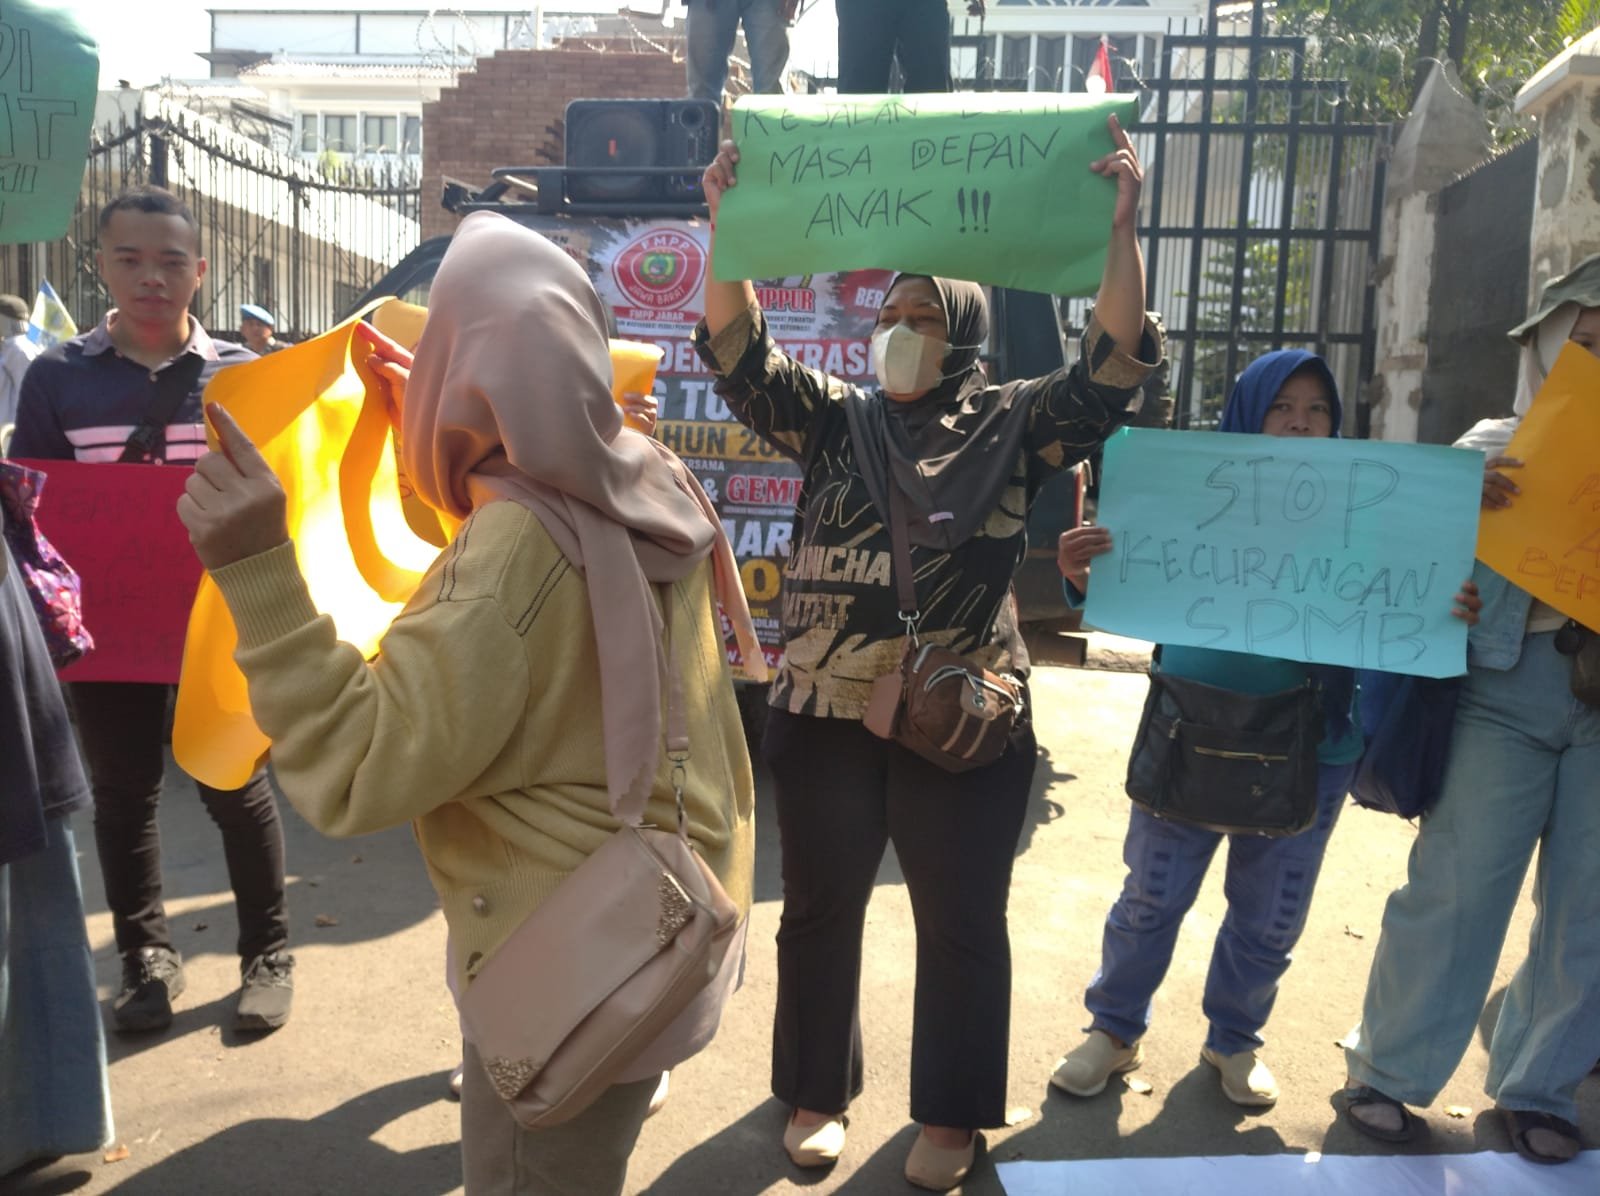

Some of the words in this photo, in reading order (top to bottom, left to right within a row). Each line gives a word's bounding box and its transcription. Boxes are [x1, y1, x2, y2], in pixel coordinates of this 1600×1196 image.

[769, 144, 872, 186] MASA
[911, 128, 1060, 174] DEPAN
[805, 188, 934, 239] ANAK
[1197, 456, 1399, 549] STOP
[1119, 529, 1439, 608] KECURANGAN
[1185, 597, 1428, 669] SPMB
